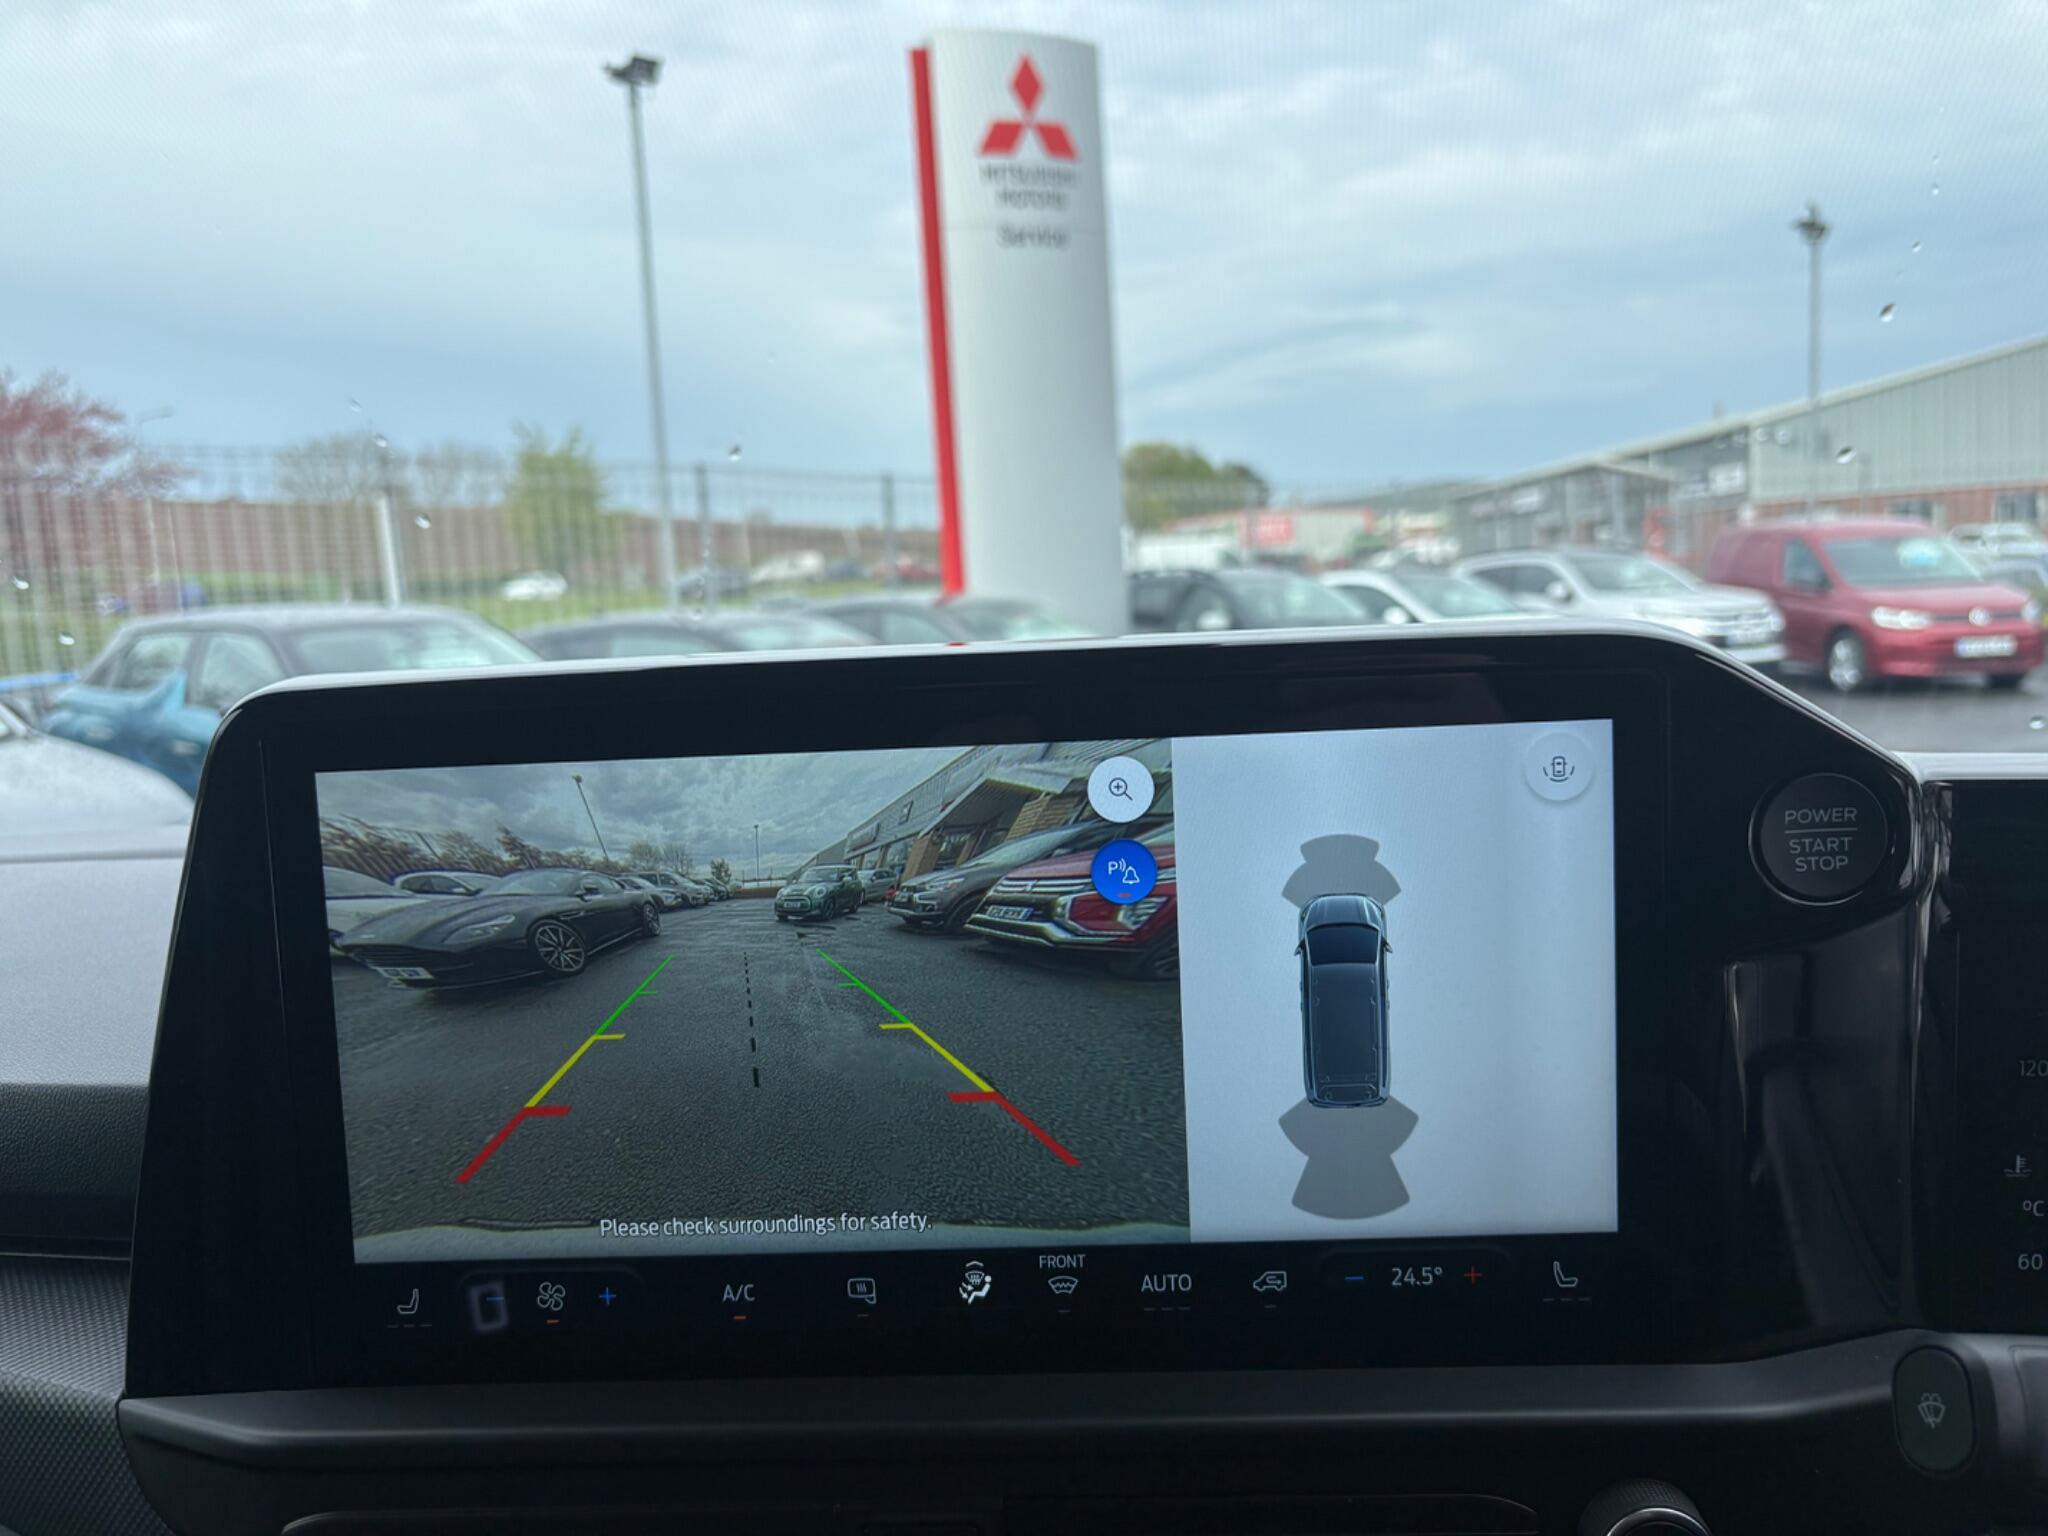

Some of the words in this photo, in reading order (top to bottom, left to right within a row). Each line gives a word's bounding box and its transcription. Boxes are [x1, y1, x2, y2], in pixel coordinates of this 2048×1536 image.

[1784, 807, 1858, 825] POWER
[1788, 836, 1853, 855] START
[1794, 855, 1849, 873] STOP
[2019, 1059, 2048, 1077] 120
[599, 1218, 659, 1238] Please
[663, 1216, 716, 1235] check
[719, 1213, 836, 1236] surroundings
[839, 1212, 866, 1231] for
[869, 1210, 933, 1232] safety.
[1038, 1253, 1086, 1270] FRONT
[2017, 1253, 2044, 1270] 60
[1140, 1273, 1193, 1293] AUTO
[1390, 1266, 1444, 1287] 24.5°
[721, 1282, 756, 1303] A/C
